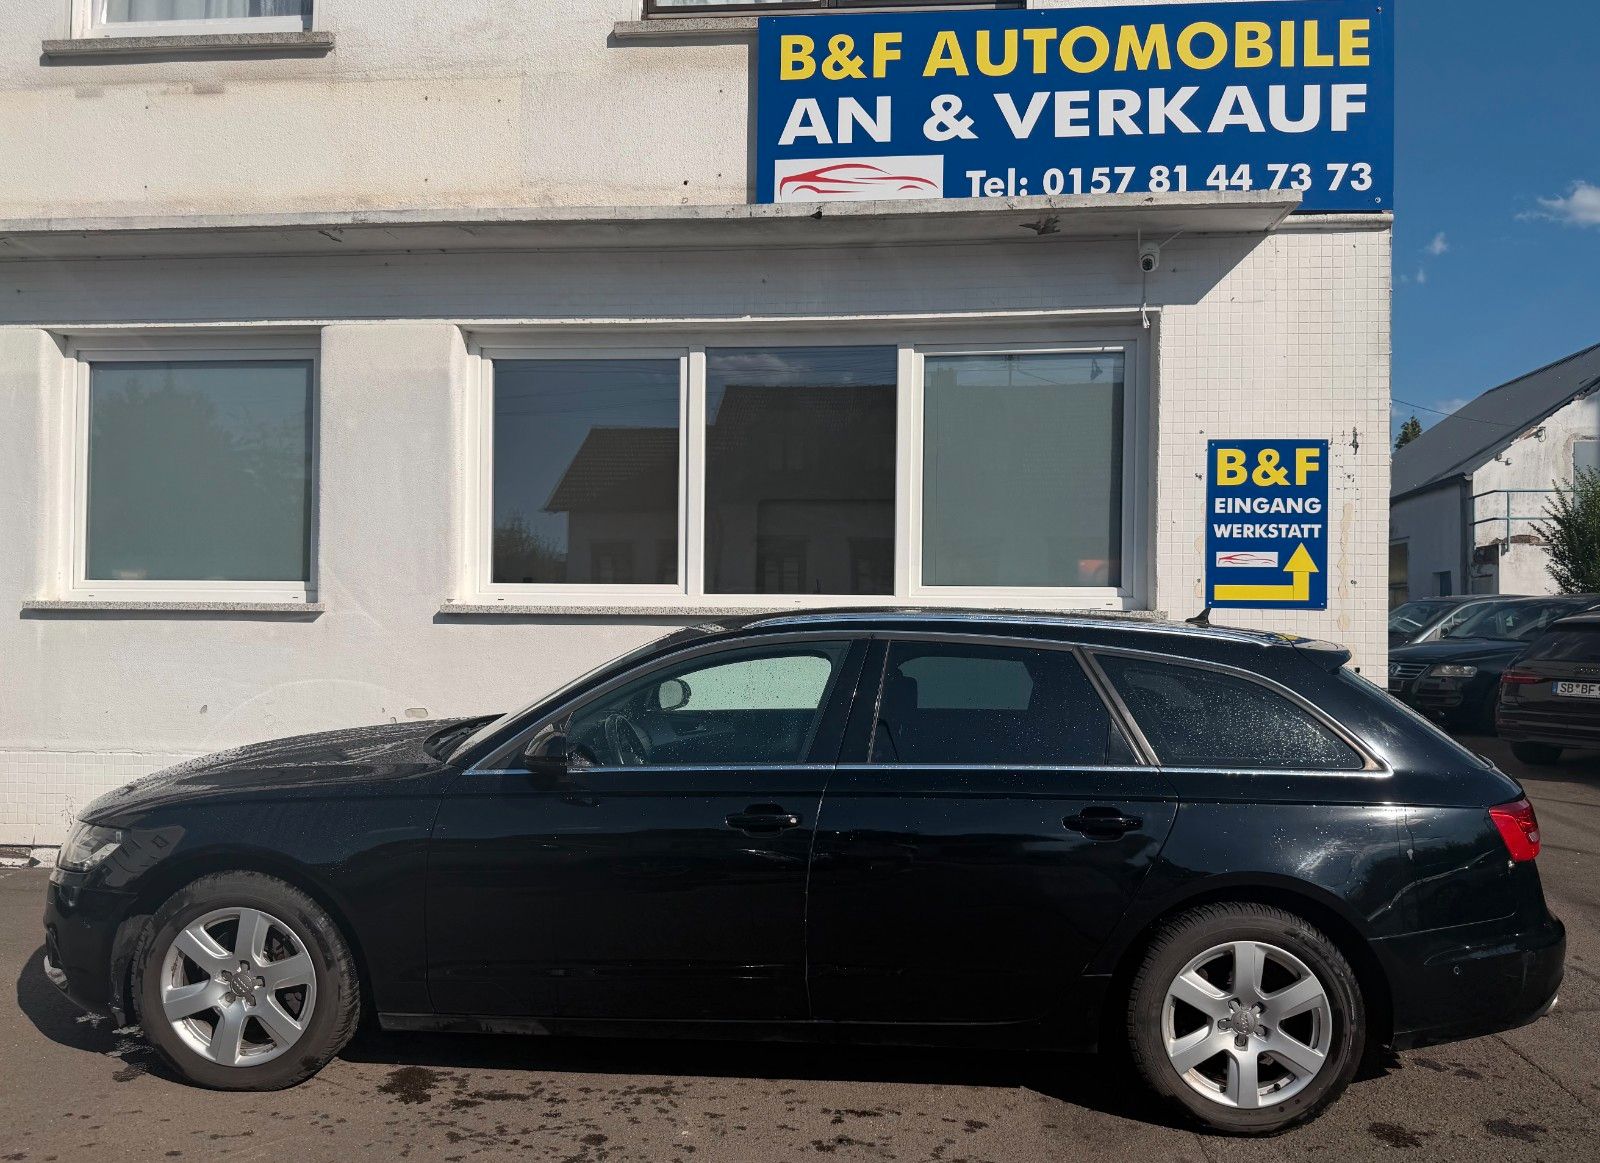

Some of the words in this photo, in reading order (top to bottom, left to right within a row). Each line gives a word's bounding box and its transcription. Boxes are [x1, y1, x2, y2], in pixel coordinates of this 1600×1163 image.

[780, 32, 903, 81] B&F
[922, 18, 1371, 77] AUTOMOBILE
[777, 95, 892, 146] AN
[922, 95, 979, 142] &
[993, 83, 1367, 139] VERKAUF
[965, 167, 1029, 198] Tel:
[1042, 166, 1137, 196] 0157
[1148, 165, 1188, 193] 81
[1205, 163, 1254, 192] 44
[1266, 163, 1312, 192] 73
[1326, 162, 1373, 191] 73
[1216, 447, 1320, 487] B&F
[1214, 497, 1322, 514] EINGANG
[1213, 523, 1322, 539] WERKSTATT
[1559, 683, 1574, 693] SB
[1580, 684, 1596, 694] BF
